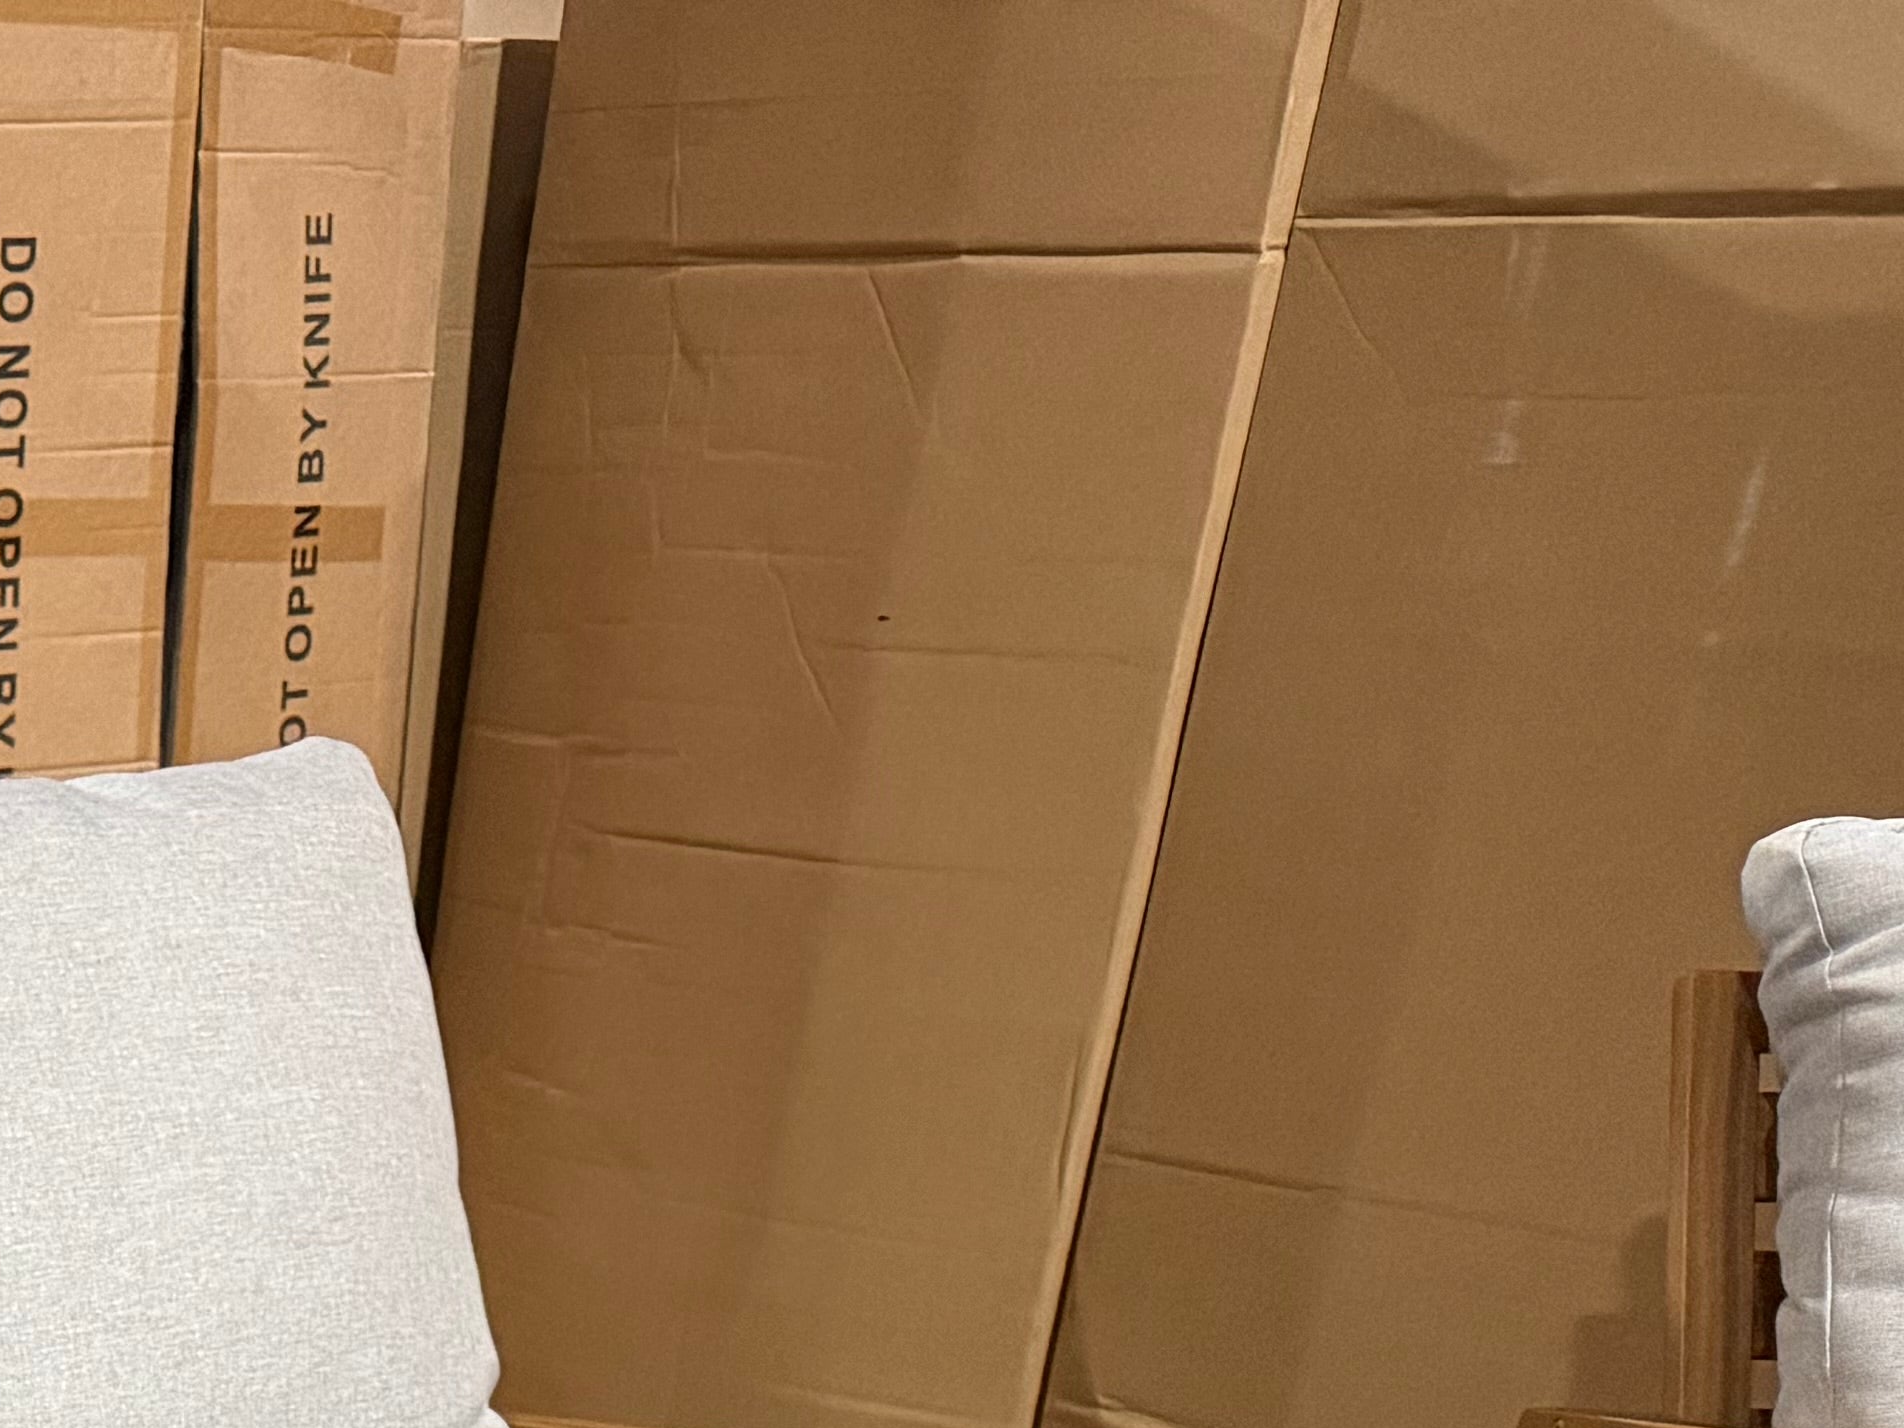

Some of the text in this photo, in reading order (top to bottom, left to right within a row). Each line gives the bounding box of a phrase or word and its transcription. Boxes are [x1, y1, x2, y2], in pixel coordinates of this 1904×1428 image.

[279, 212, 333, 748] OT OPEN BY KNIFE
